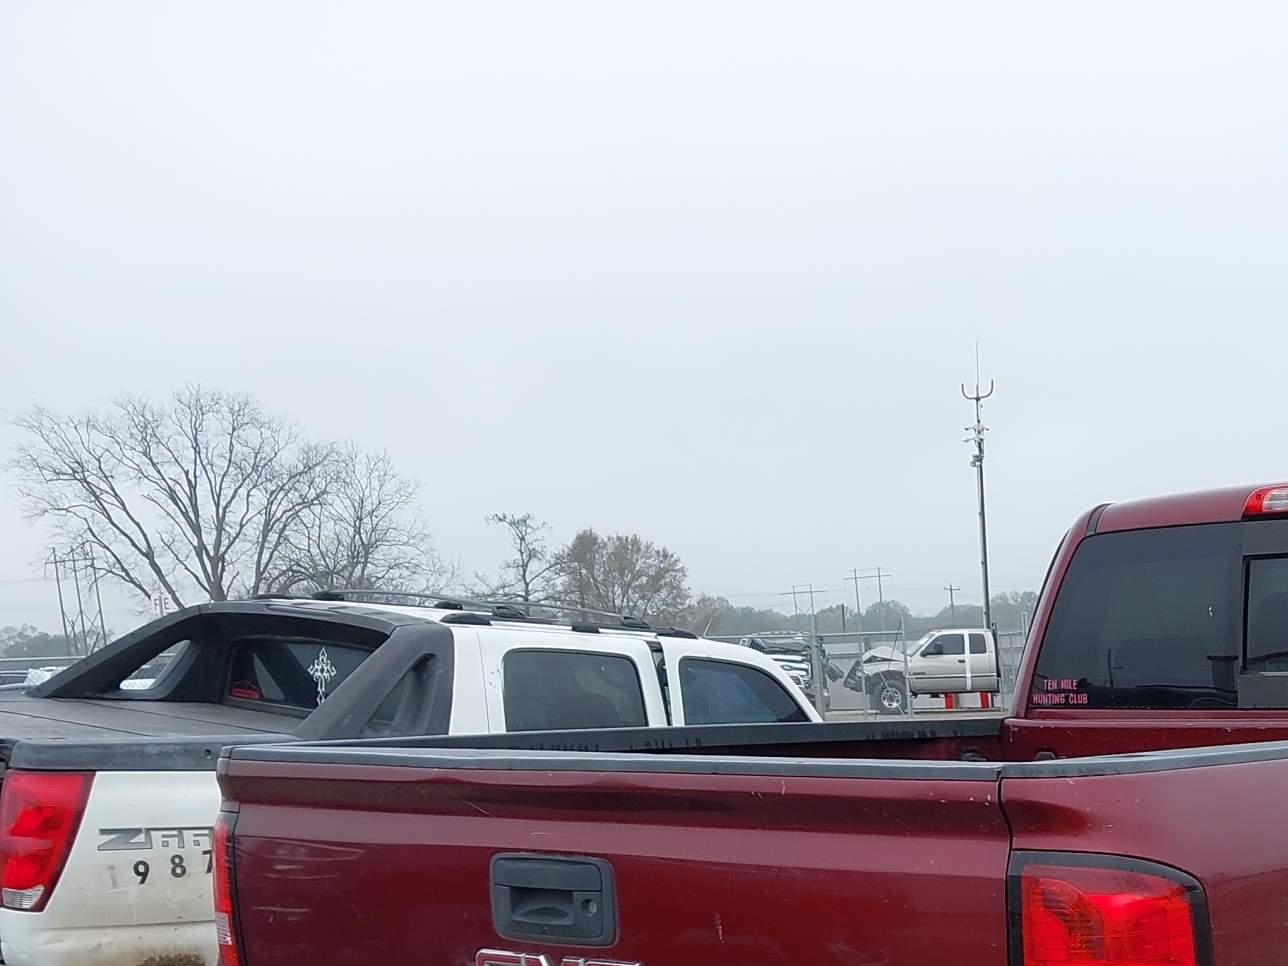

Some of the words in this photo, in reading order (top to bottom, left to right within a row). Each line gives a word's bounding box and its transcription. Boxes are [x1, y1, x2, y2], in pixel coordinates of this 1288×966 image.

[1043, 679, 1058, 690] TEN
[1061, 679, 1078, 690] MILE
[1033, 693, 1066, 704] HUNTING
[1068, 693, 1089, 704] CLUB
